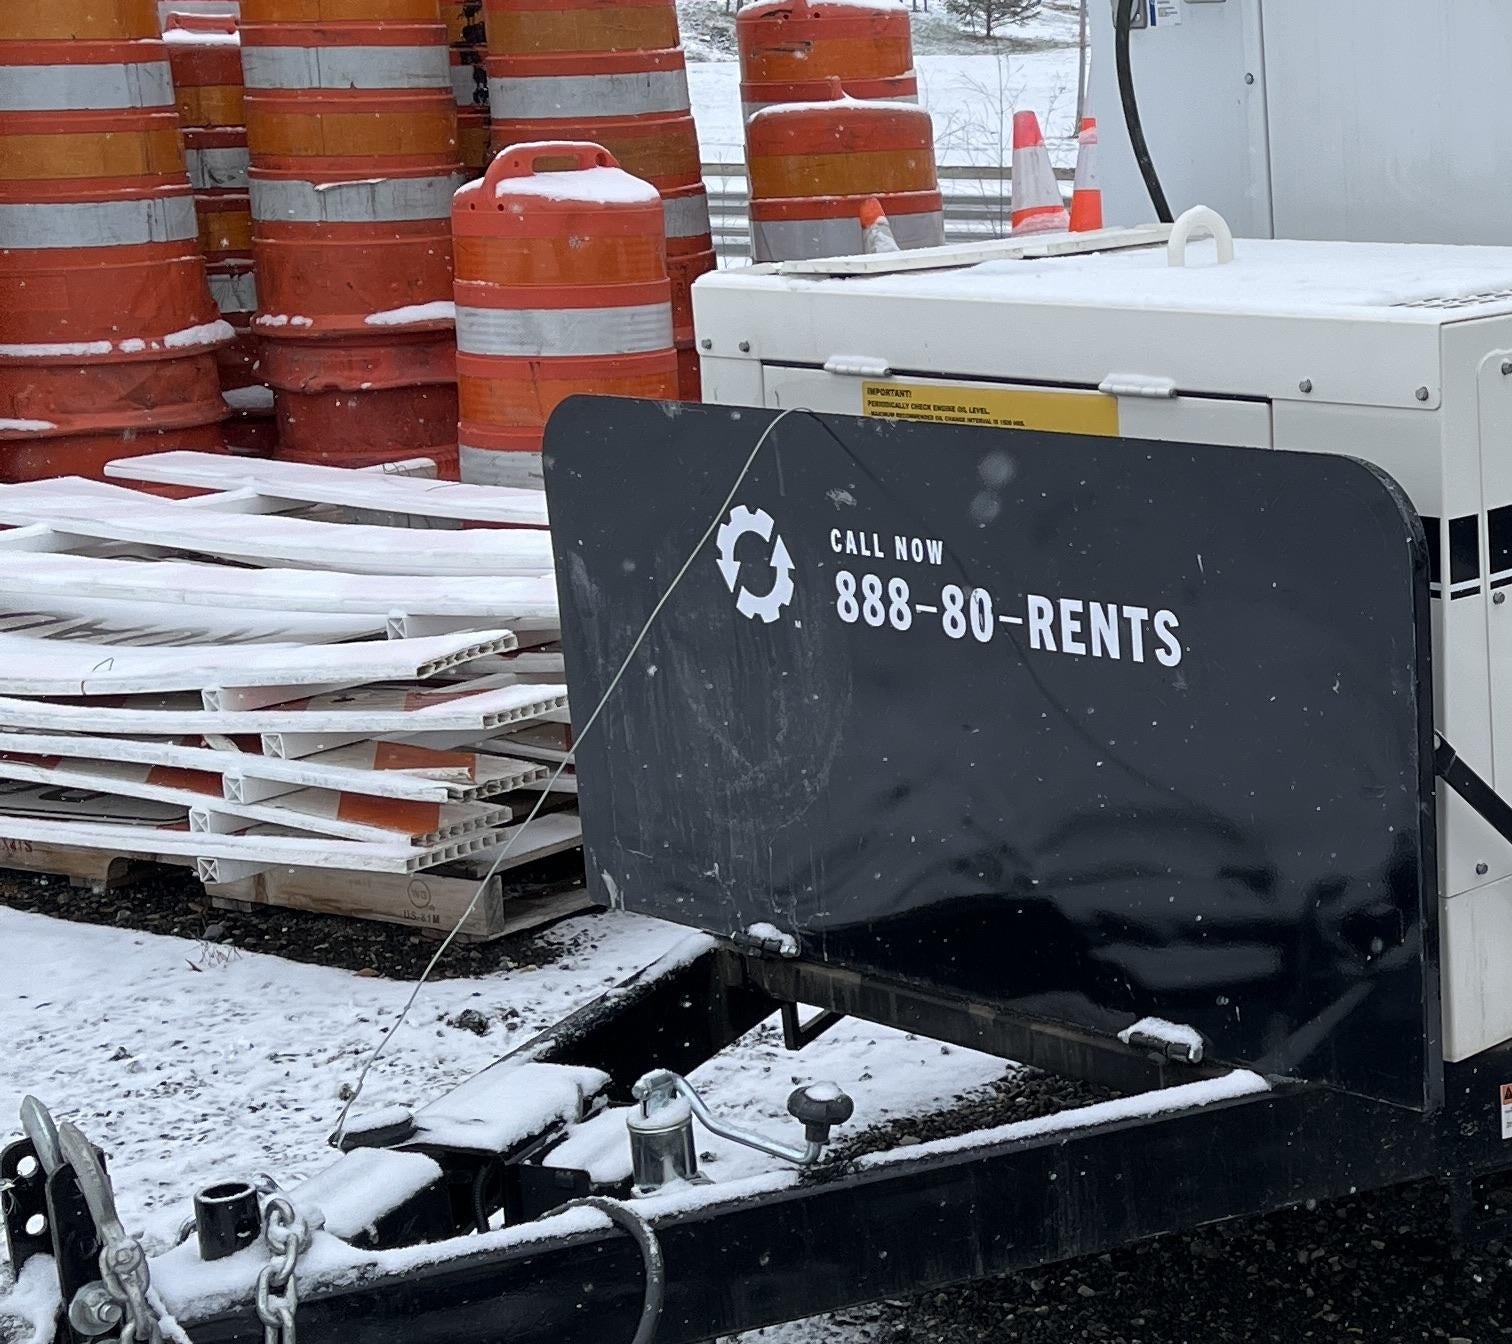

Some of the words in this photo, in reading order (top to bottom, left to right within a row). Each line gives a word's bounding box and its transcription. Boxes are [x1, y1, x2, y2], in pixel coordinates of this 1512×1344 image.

[866, 387, 912, 398] IMPORTANT!
[910, 403, 932, 411] CHECK
[830, 528, 885, 559] CALL
[894, 535, 943, 566] NOW
[834, 570, 1182, 668] 888-80-RENTS
